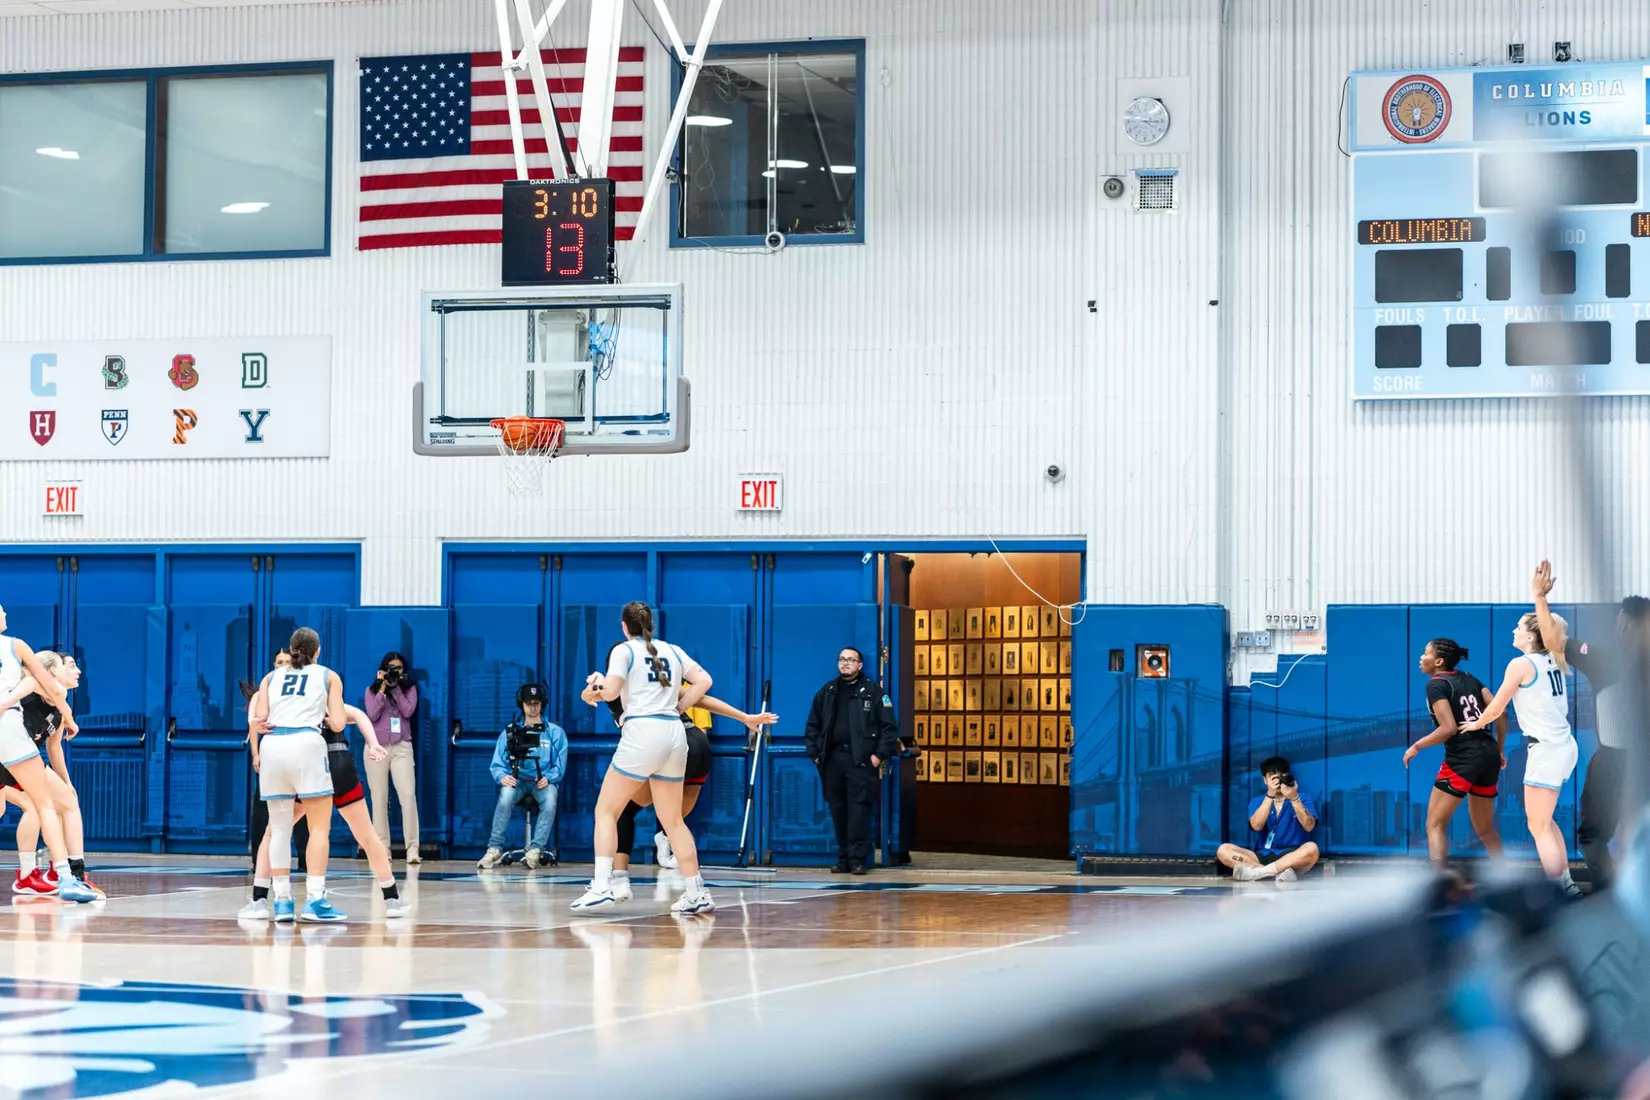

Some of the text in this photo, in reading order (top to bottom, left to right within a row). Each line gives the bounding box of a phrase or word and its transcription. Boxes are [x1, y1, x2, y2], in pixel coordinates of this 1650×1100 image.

[1492, 79, 1626, 100] COLUMBIA
[1430, 89, 1443, 116] ELECTRICAL
[1524, 110, 1592, 126] LIONS
[535, 188, 598, 219] 3:10
[1369, 219, 1473, 243] COLUMBIA
[546, 223, 584, 275] 13
[1375, 308, 1426, 324] FOULS
[1443, 306, 1486, 323] T.O.L.
[1504, 304, 1614, 321] PLAYER FOUL
[30, 353, 57, 397] C
[242, 352, 267, 388] D
[1373, 375, 1424, 391] SCORE
[35, 413, 51, 436] H
[103, 411, 127, 419] PENN
[173, 409, 197, 444] P
[239, 408, 270, 443] Y
[110, 422, 122, 438] P
[46, 487, 78, 513] EXIT
[741, 480, 777, 508] EXIT
[281, 674, 309, 697] 21
[1547, 669, 1564, 697] 10
[1459, 694, 1482, 721] 23
